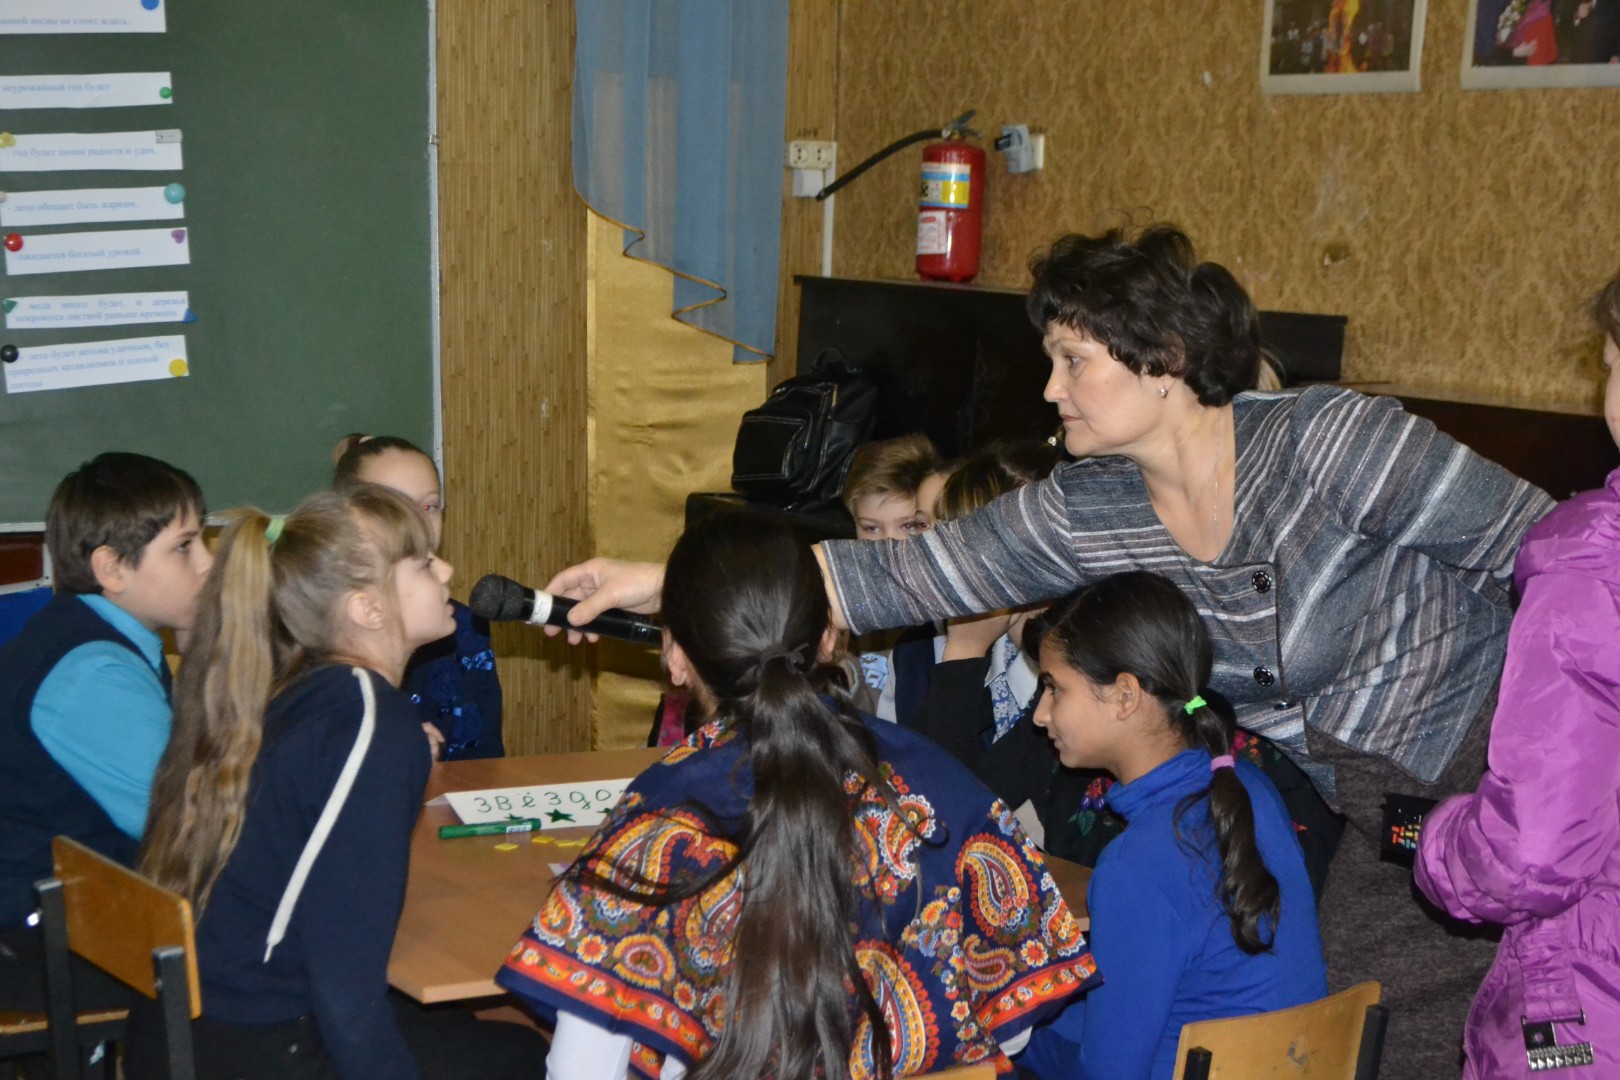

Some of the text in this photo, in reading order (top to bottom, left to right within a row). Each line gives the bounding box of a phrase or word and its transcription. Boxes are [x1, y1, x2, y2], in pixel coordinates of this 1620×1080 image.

[67, 84, 83, 92] год
[84, 82, 110, 93] будет
[30, 148, 56, 159] будет
[87, 148, 123, 158] радости
[36, 202, 74, 211] обещает
[76, 201, 99, 210] быть
[18, 252, 66, 261] ожидается
[67, 249, 105, 258] богатый
[61, 301, 88, 309] много
[104, 312, 138, 321] раньше
[29, 353, 49, 361] лето
[50, 350, 76, 360] будет
[78, 348, 109, 356] весьма
[154, 341, 169, 349] без
